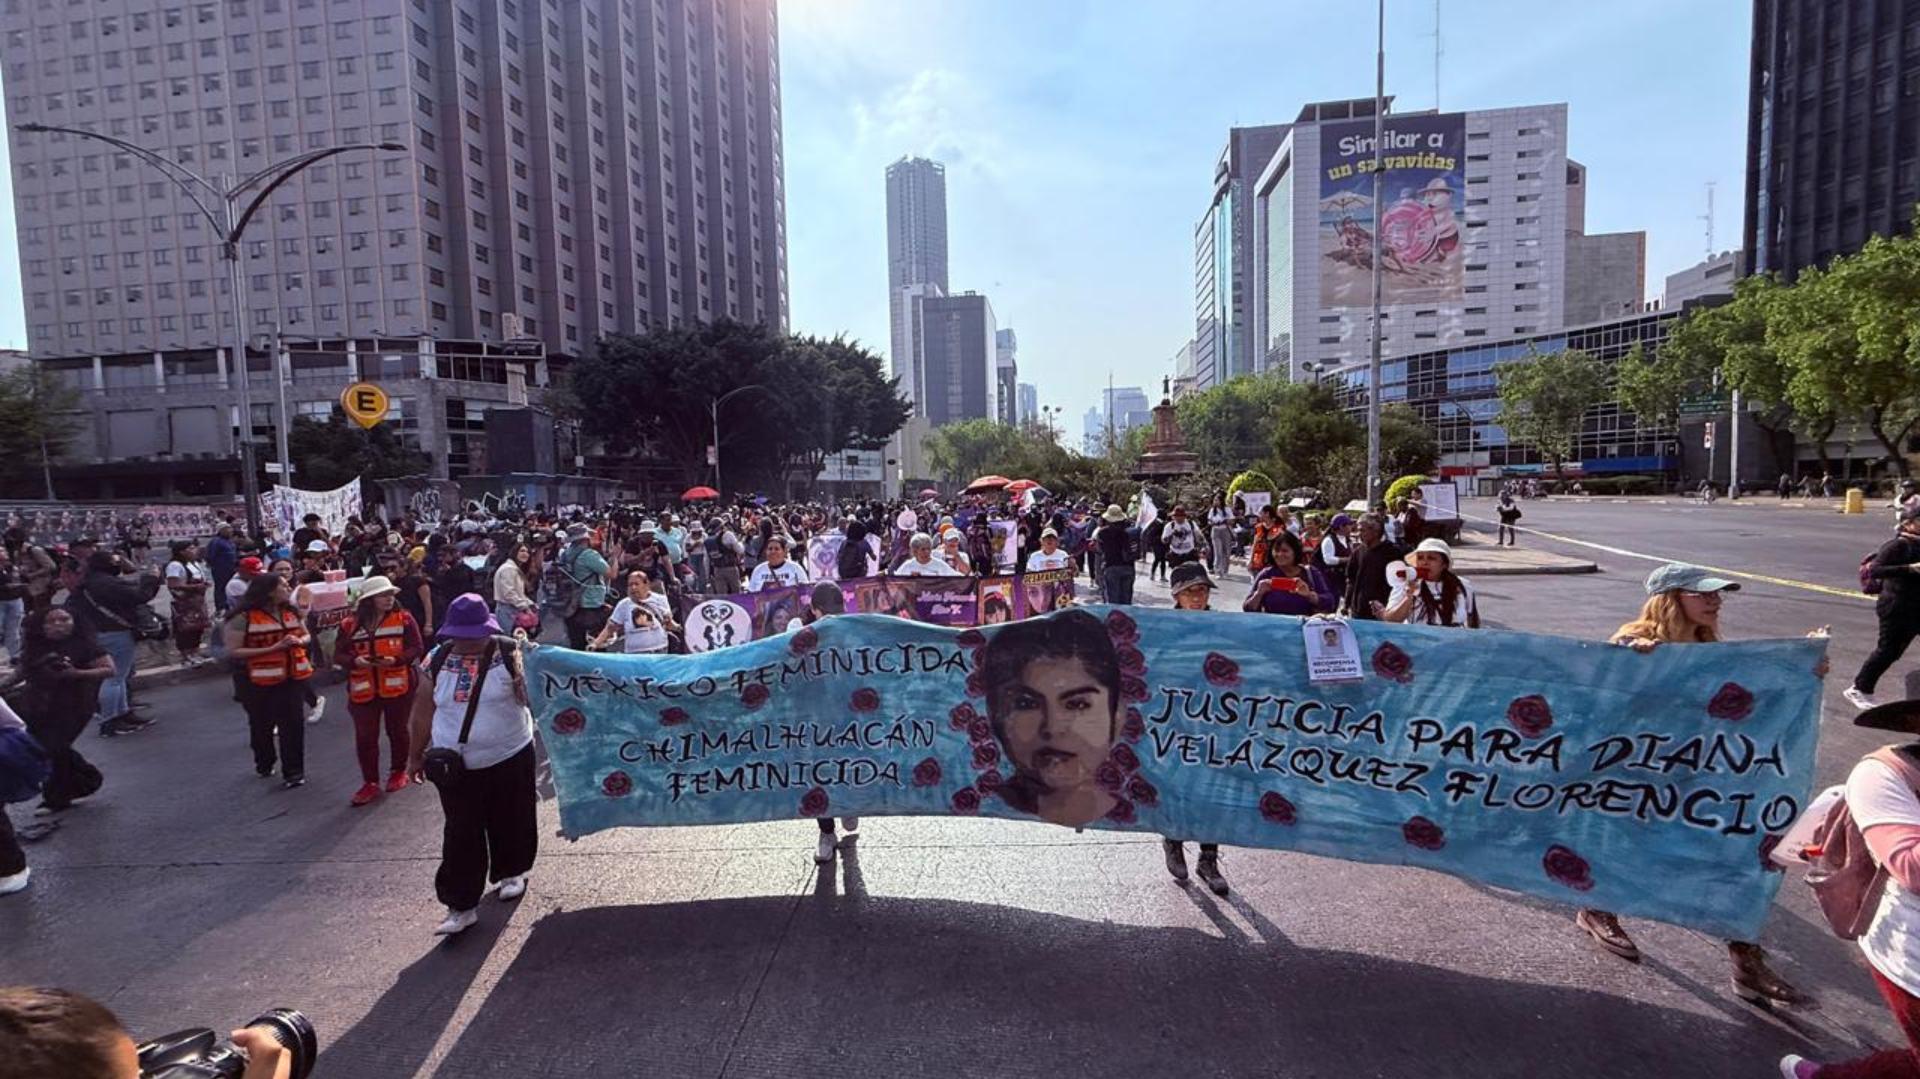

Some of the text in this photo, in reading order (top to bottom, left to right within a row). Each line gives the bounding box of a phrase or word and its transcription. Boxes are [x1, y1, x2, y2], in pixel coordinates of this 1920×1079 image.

[1338, 130, 1444, 156] Similar a
[1327, 152, 1456, 181] un savavidas
[357, 391, 377, 412] E
[543, 644, 970, 698] MÉXICO FEMINICIDA
[619, 714, 935, 763] CHIMALHUACÁN
[1150, 688, 1786, 777] JUSTICIA PARA DIANA
[667, 759, 903, 802] FEMINICIDA
[1150, 727, 1798, 836] VELÁZQUEZ FLORENCIO
